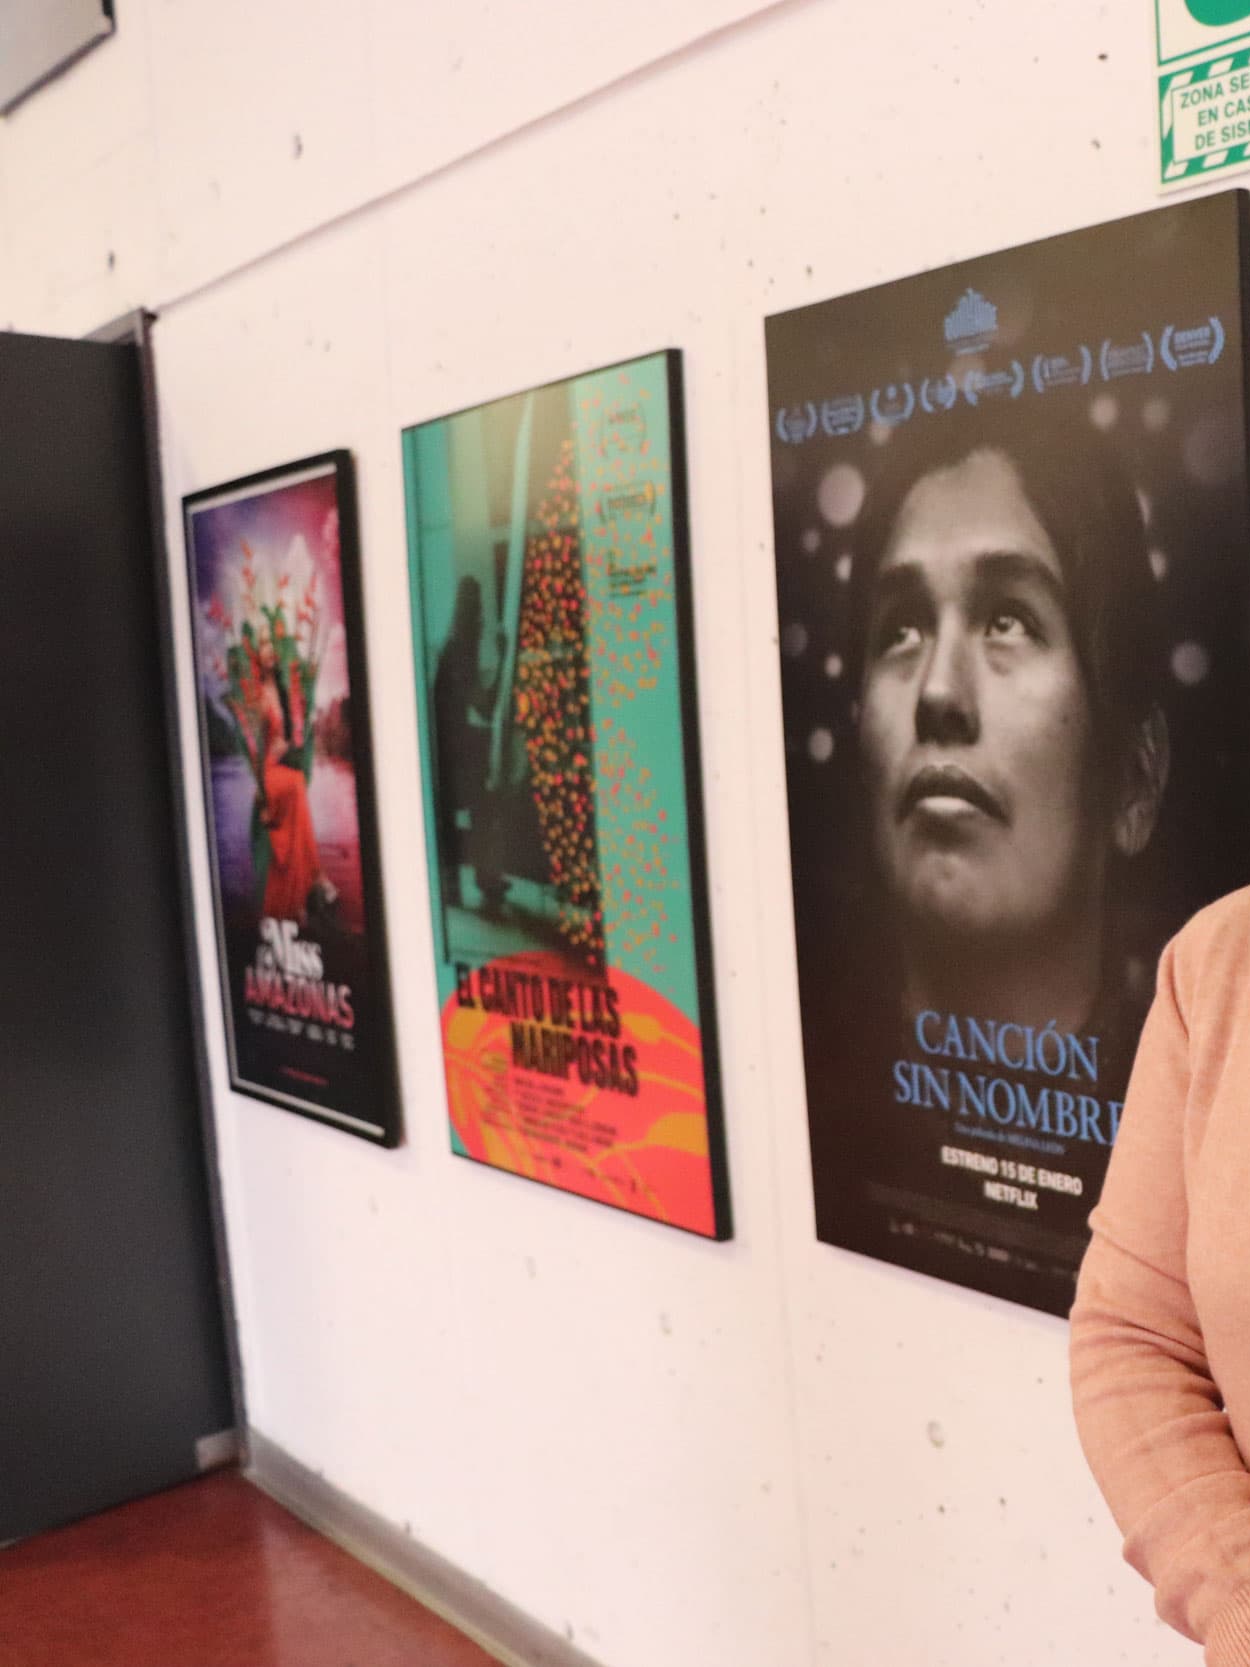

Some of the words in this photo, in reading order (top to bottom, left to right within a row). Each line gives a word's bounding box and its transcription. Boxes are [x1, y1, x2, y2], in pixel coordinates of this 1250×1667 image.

[1180, 82, 1224, 109] ZONA
[1198, 107, 1218, 126] EN
[1195, 131, 1216, 150] DE
[456, 963, 477, 1009] EL
[479, 966, 544, 1022] CANTO
[547, 977, 574, 1028] DE
[577, 983, 621, 1039] LAS
[510, 1021, 638, 1097] MARIPOSAS
[915, 1010, 1099, 1082] CANCIÓN
[893, 1060, 950, 1111] SIN
[941, 1145, 999, 1176] ESTRENO
[1000, 1160, 1017, 1180] 15
[1017, 1163, 1036, 1185] DE
[1037, 1168, 1083, 1196] ENERO
[984, 1180, 1039, 1211] NETFLIX
